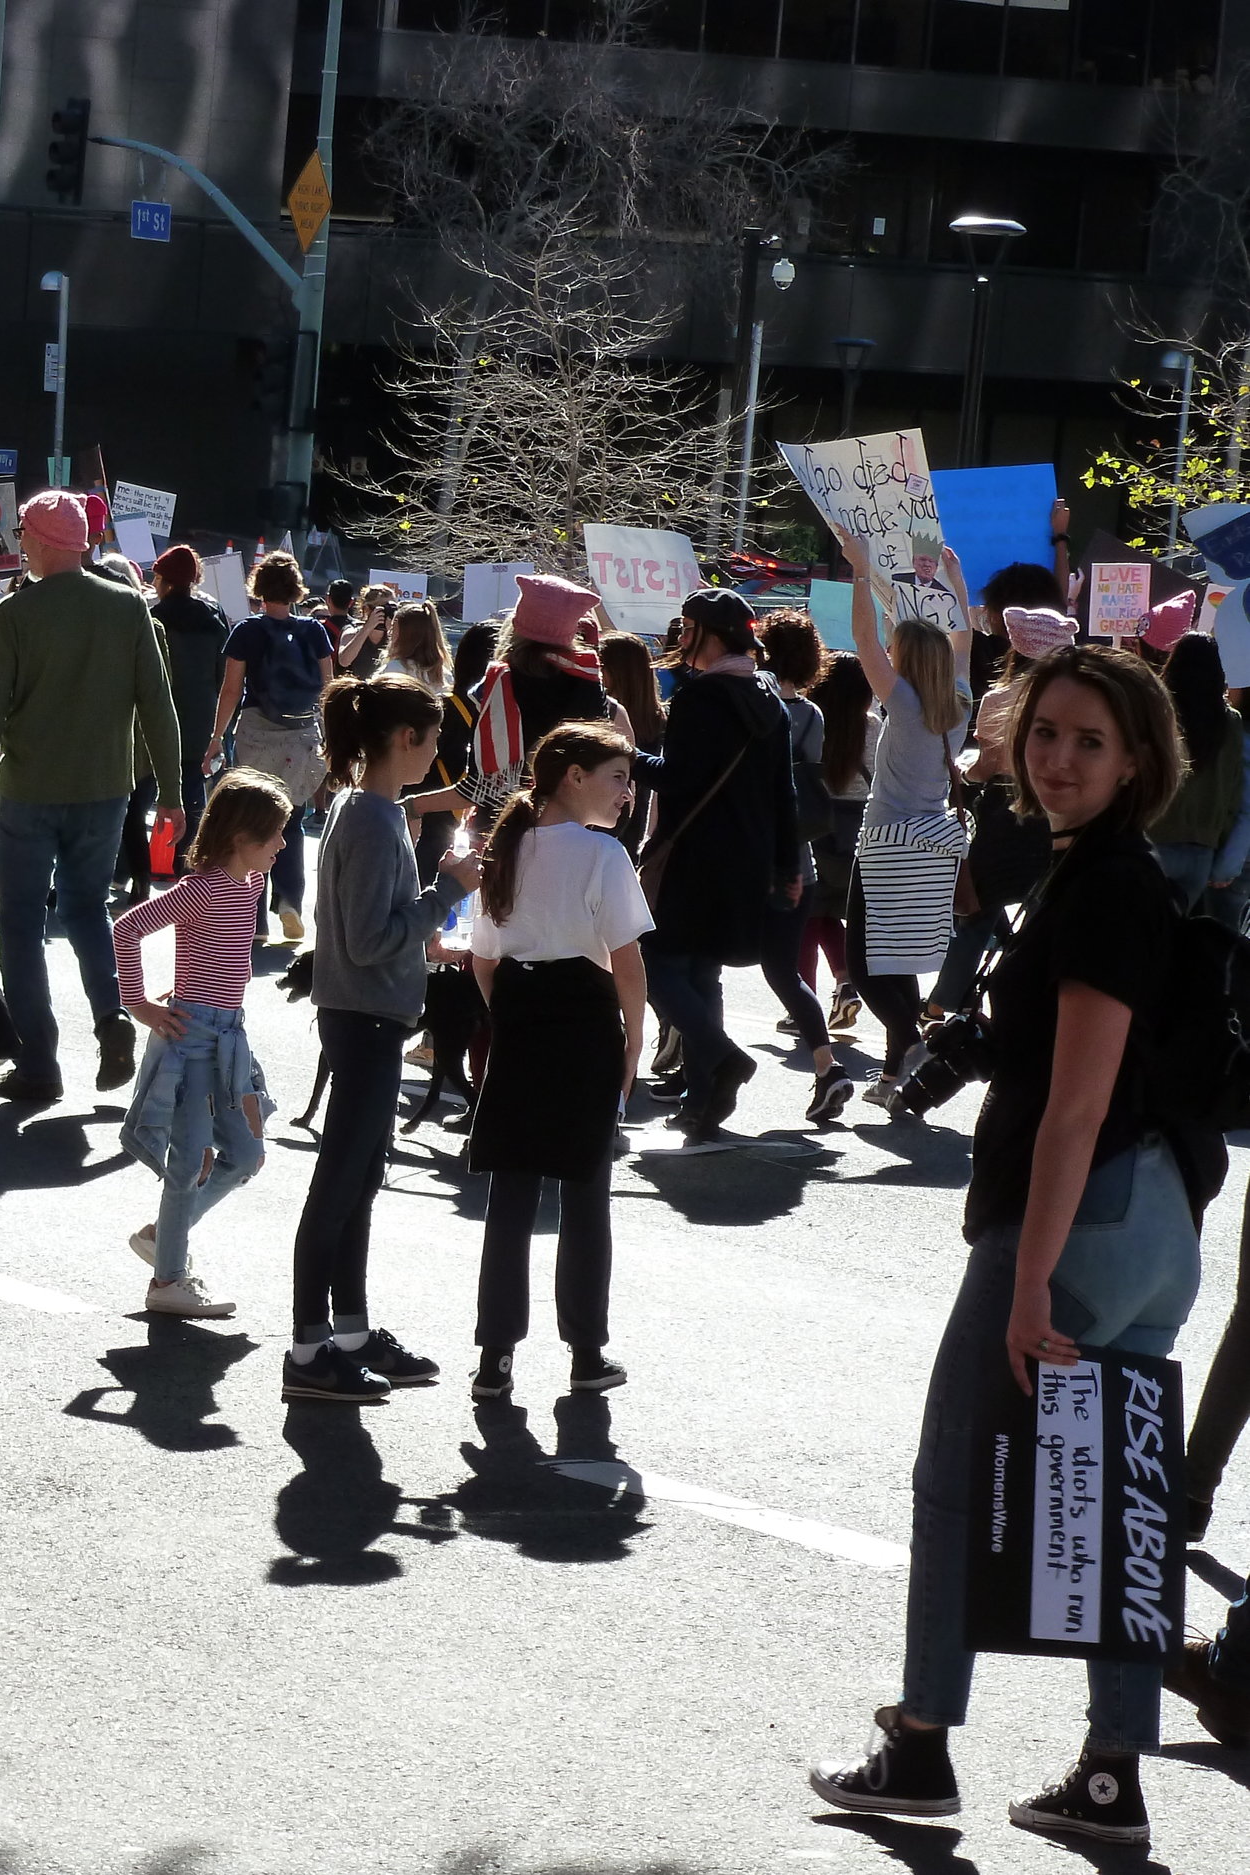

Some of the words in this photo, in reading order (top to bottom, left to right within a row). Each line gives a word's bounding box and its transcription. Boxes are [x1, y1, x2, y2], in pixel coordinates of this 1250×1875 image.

[137, 208, 150, 231] 1st
[153, 212, 166, 232] St
[853, 433, 909, 494] died
[112, 502, 124, 511] me
[134, 489, 144, 498] the
[145, 493, 161, 502] next
[154, 502, 167, 512] fine
[838, 488, 898, 538] made
[878, 544, 899, 570] of
[1099, 567, 1141, 582] LOVE
[1097, 582, 1116, 593] NOT
[1117, 583, 1143, 593] HATE
[1101, 594, 1139, 606] MAKES
[1097, 606, 1143, 618] AMERICA
[1099, 619, 1139, 632] GREAT
[1040, 1369, 1067, 1416] this
[1068, 1368, 1098, 1422] The
[1122, 1366, 1169, 1493] RISE
[991, 1433, 1010, 1553] #WomensWave
[1069, 1444, 1098, 1518] idiots
[1037, 1434, 1068, 1572] government
[1068, 1535, 1095, 1584] who
[1122, 1485, 1172, 1653] ABOVE
[1065, 1593, 1085, 1633] run
